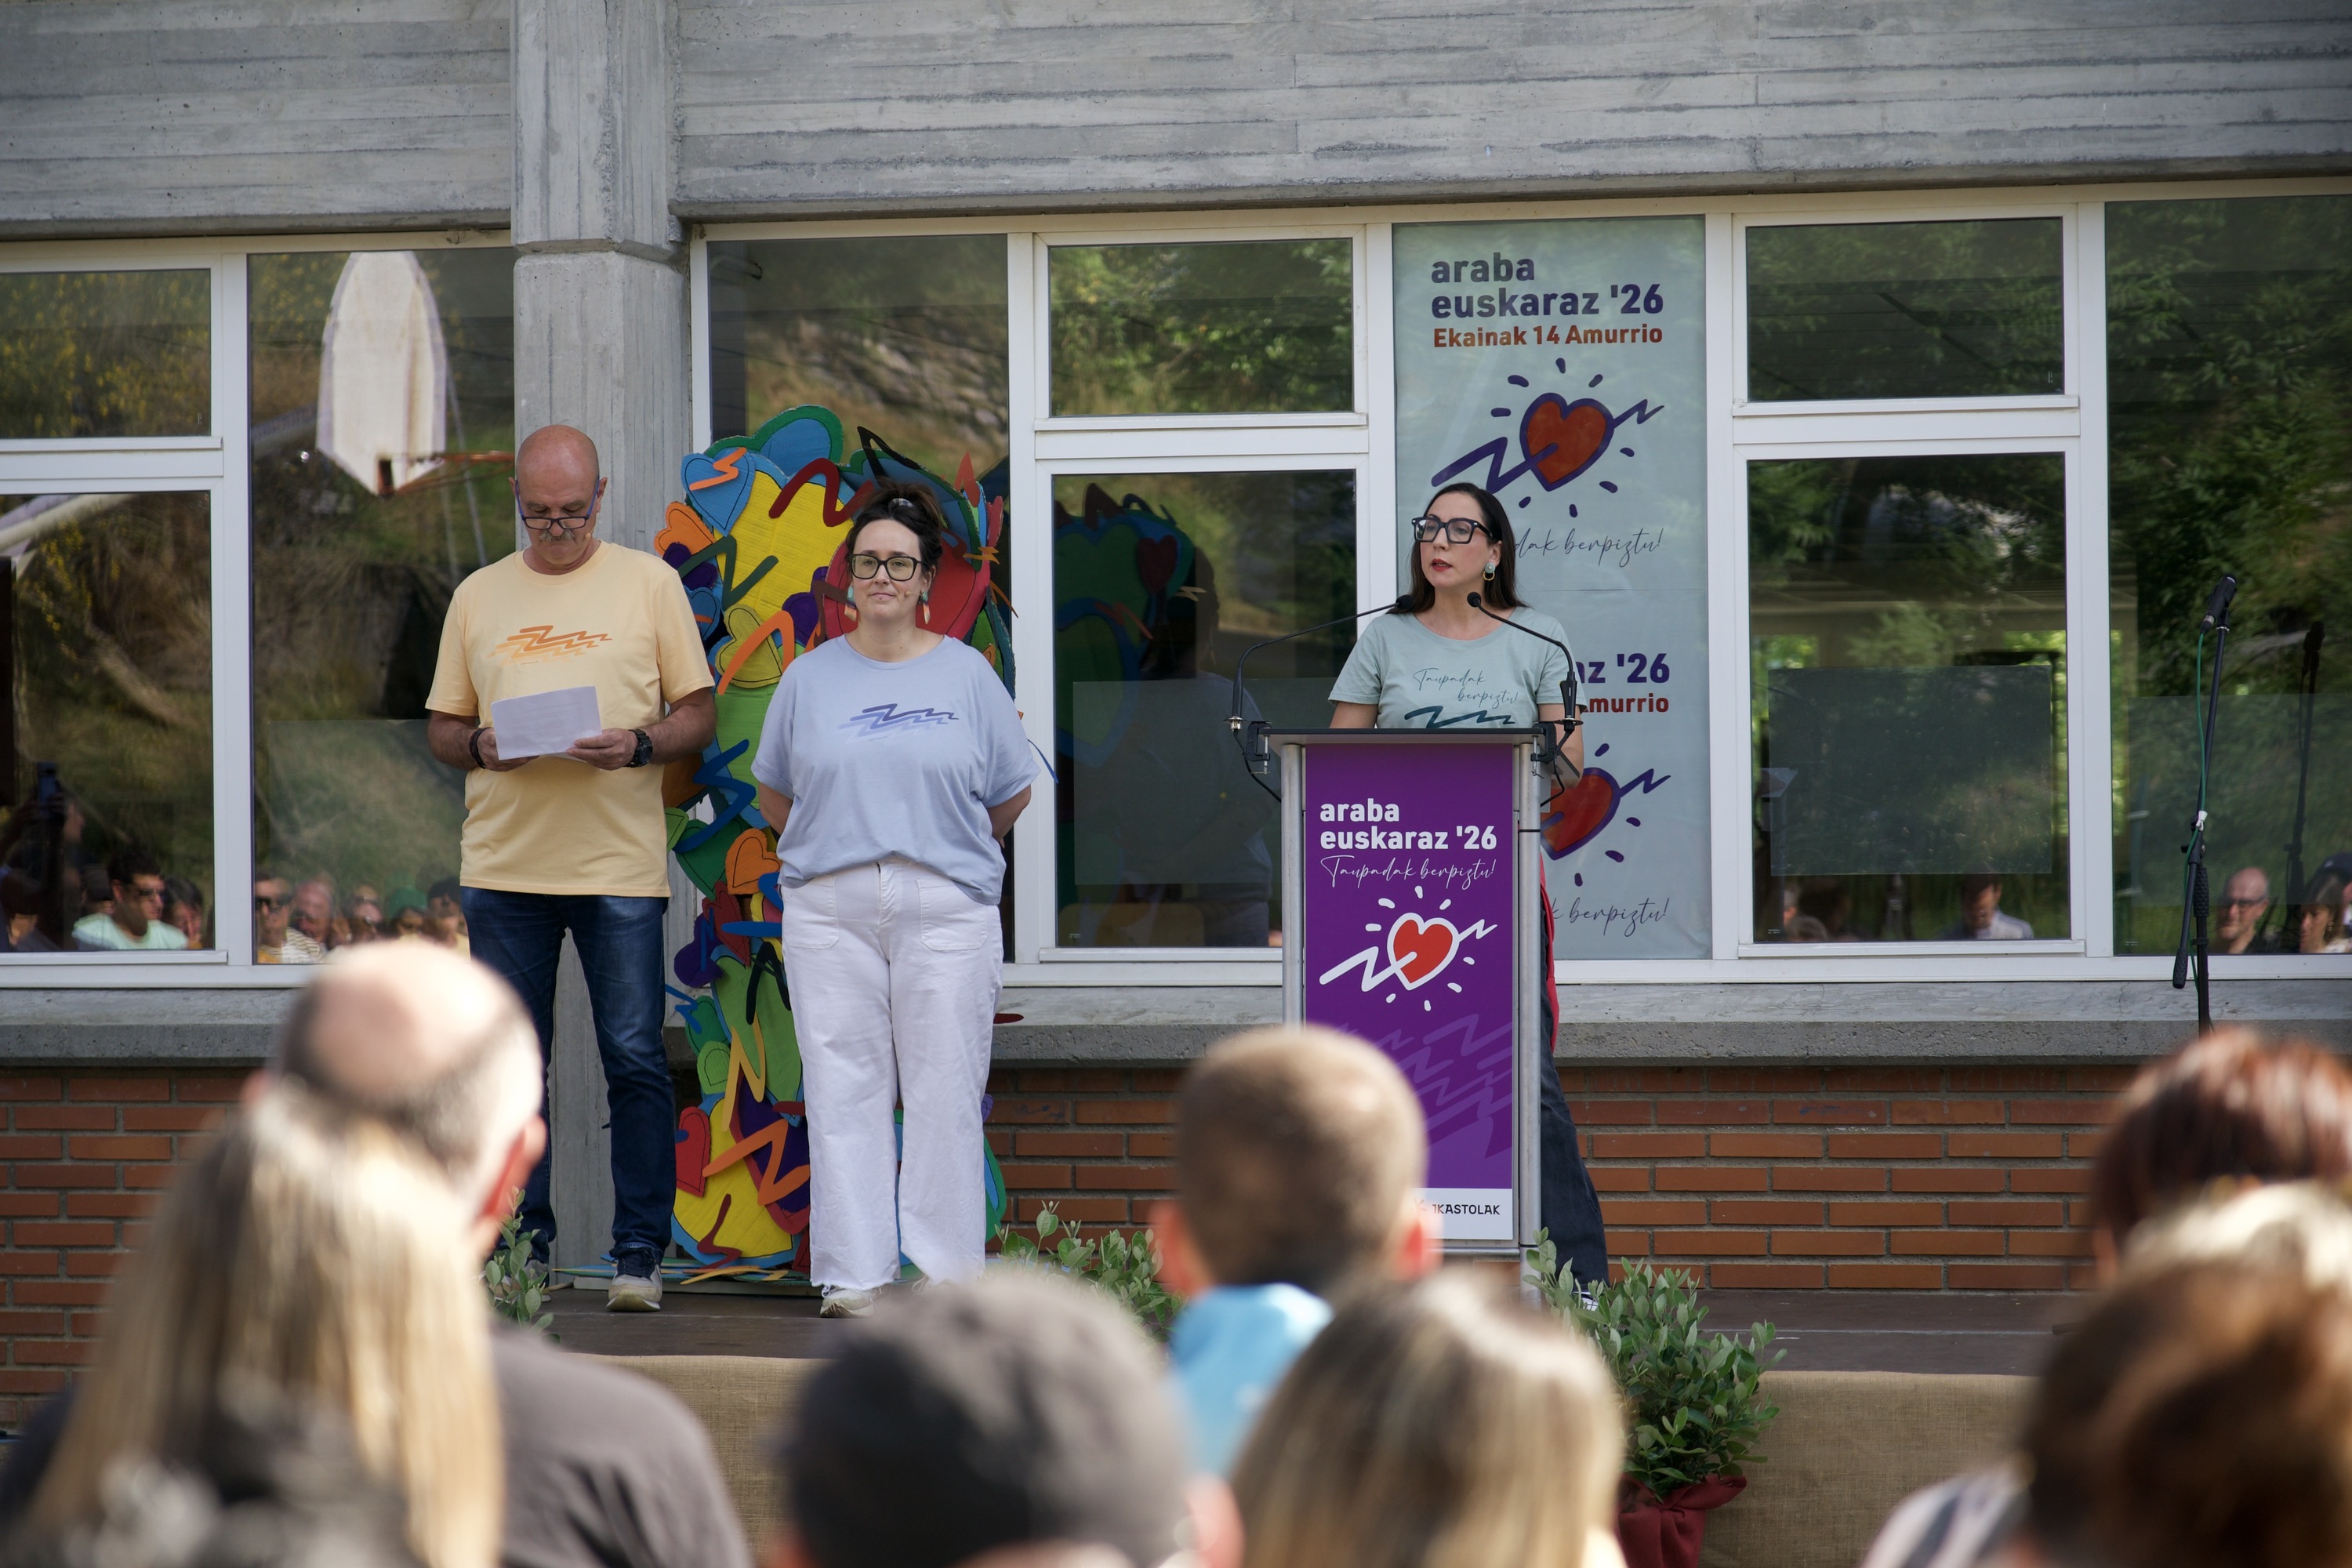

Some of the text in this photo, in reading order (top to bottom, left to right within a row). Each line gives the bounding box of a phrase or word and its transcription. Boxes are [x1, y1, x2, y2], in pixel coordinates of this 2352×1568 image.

[1431, 252, 1535, 283] araba
[1431, 283, 1664, 318] euskaraz '26
[1433, 323, 1663, 347] Ekainak 14 Amurrio
[1565, 528, 1664, 568] berpiztu!
[1413, 667, 1486, 691] Taupadak
[1617, 652, 1670, 684] '26
[1583, 693, 1669, 713] murrio
[1319, 798, 1400, 822] araba
[1319, 825, 1497, 850] euskaraz '26
[1320, 855, 1497, 890] Taupadak berpiztu!
[1570, 897, 1669, 937] berpiztu!
